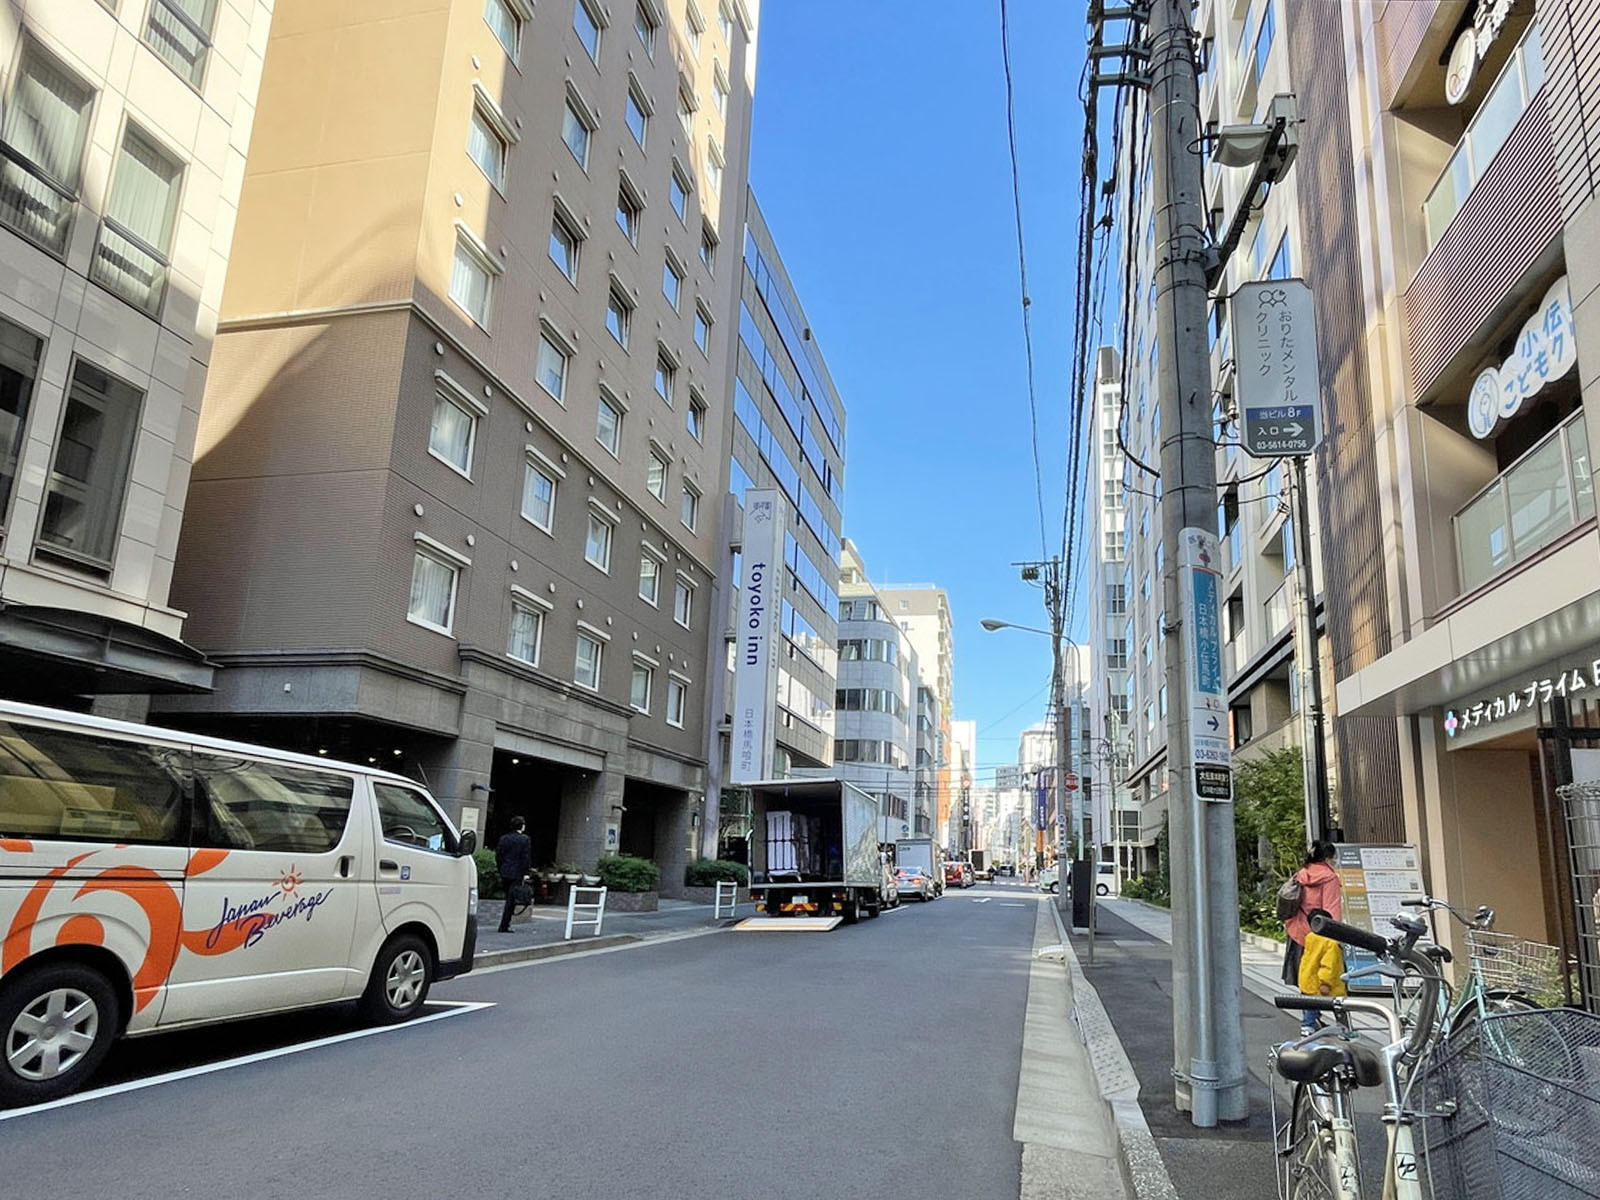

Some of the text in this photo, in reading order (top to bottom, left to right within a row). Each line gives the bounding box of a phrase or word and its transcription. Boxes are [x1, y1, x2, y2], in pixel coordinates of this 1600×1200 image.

[1256, 312, 1272, 376] クリニック
[1278, 311, 1298, 401] おりたメンタル
[1258, 426, 1279, 436] 入口
[746, 562, 766, 665] toyoko inn
[206, 891, 281, 949] Japan
[236, 888, 334, 949] Beverage
